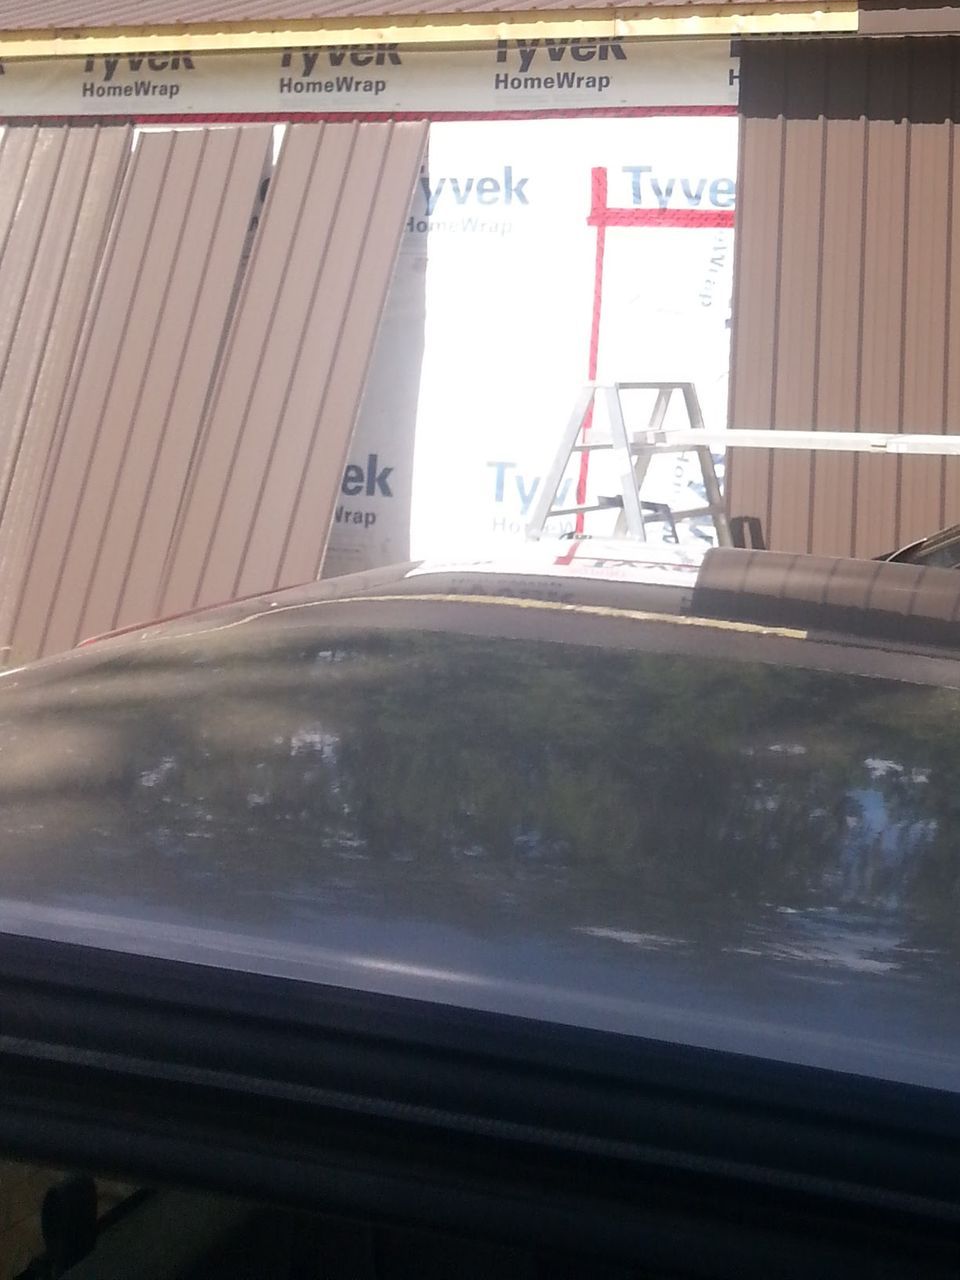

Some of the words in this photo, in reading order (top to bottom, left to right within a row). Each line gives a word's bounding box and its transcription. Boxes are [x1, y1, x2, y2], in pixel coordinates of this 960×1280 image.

[281, 43, 402, 77] Tyvek
[497, 36, 627, 73] Tyvek
[82, 81, 180, 99] HomeWrap
[280, 76, 386, 95] HomeWrap
[495, 72, 611, 92] HomeWrap
[420, 165, 530, 216] yvek
